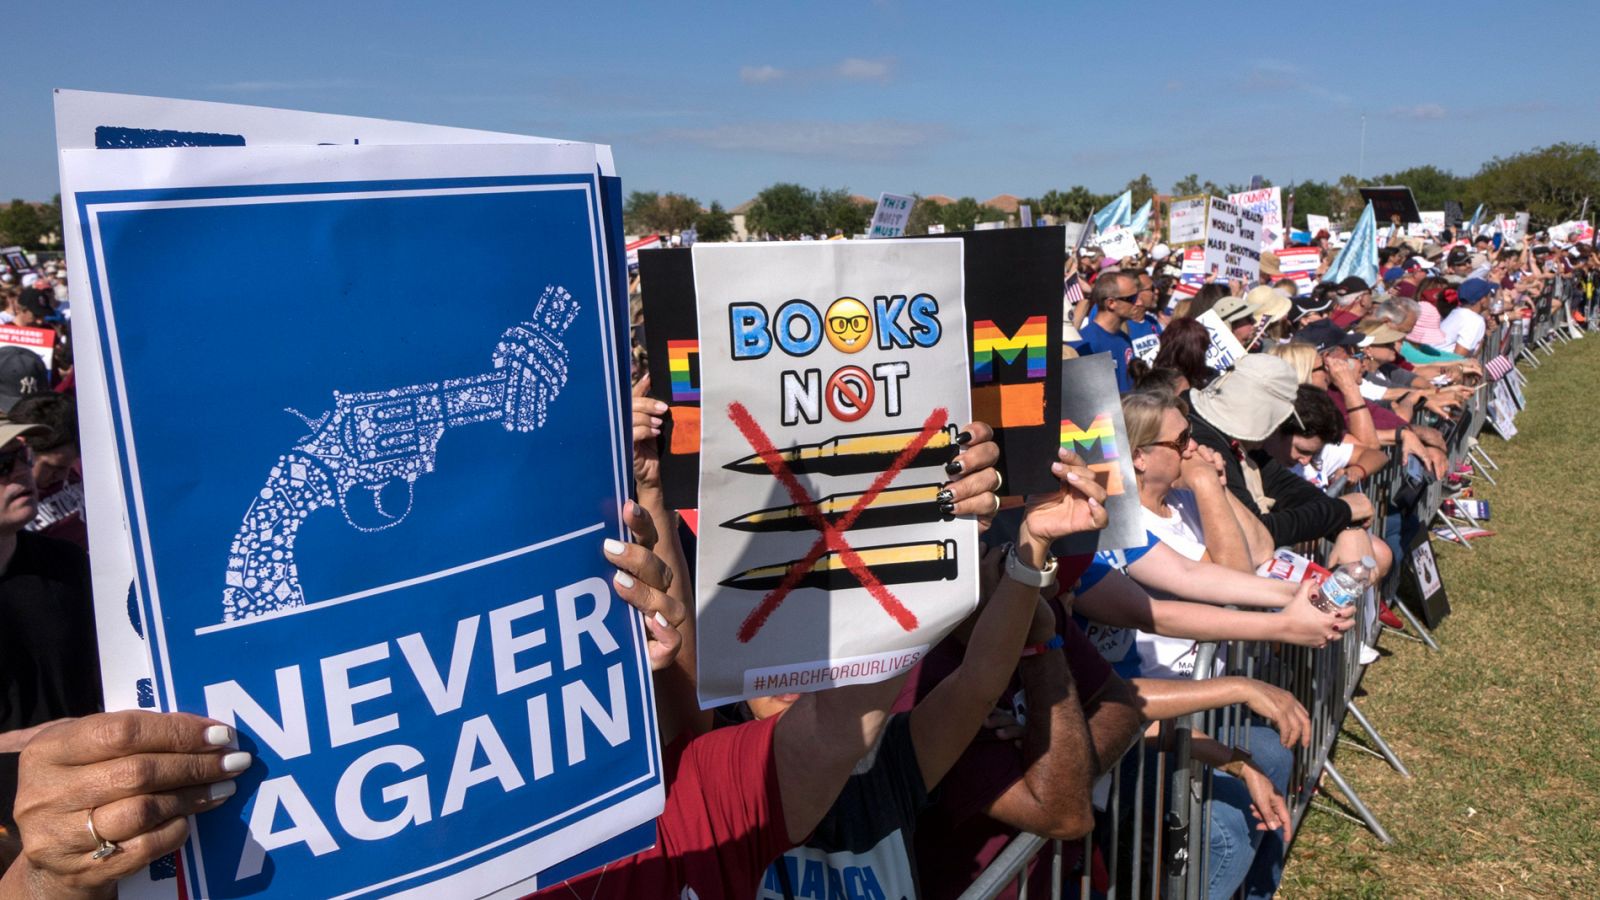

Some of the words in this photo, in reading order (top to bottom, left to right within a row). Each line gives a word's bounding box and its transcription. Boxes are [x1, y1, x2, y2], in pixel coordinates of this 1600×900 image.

[883, 197, 907, 210] THIS
[1211, 199, 1239, 216] MENTAL
[1241, 208, 1264, 225] HEALTH
[874, 226, 900, 236] MUST
[1211, 218, 1236, 234] WORLD
[1239, 228, 1255, 241] WIDE
[1236, 217, 1243, 228] IS
[1206, 238, 1227, 251] MASS
[1225, 253, 1241, 266] ONLY
[780, 361, 909, 427] NOT
[203, 576, 620, 760] NEVER
[753, 651, 920, 691] #MARCHFOROURLIVES
[234, 661, 632, 882] AGAIN
[764, 855, 886, 900] MARCH
